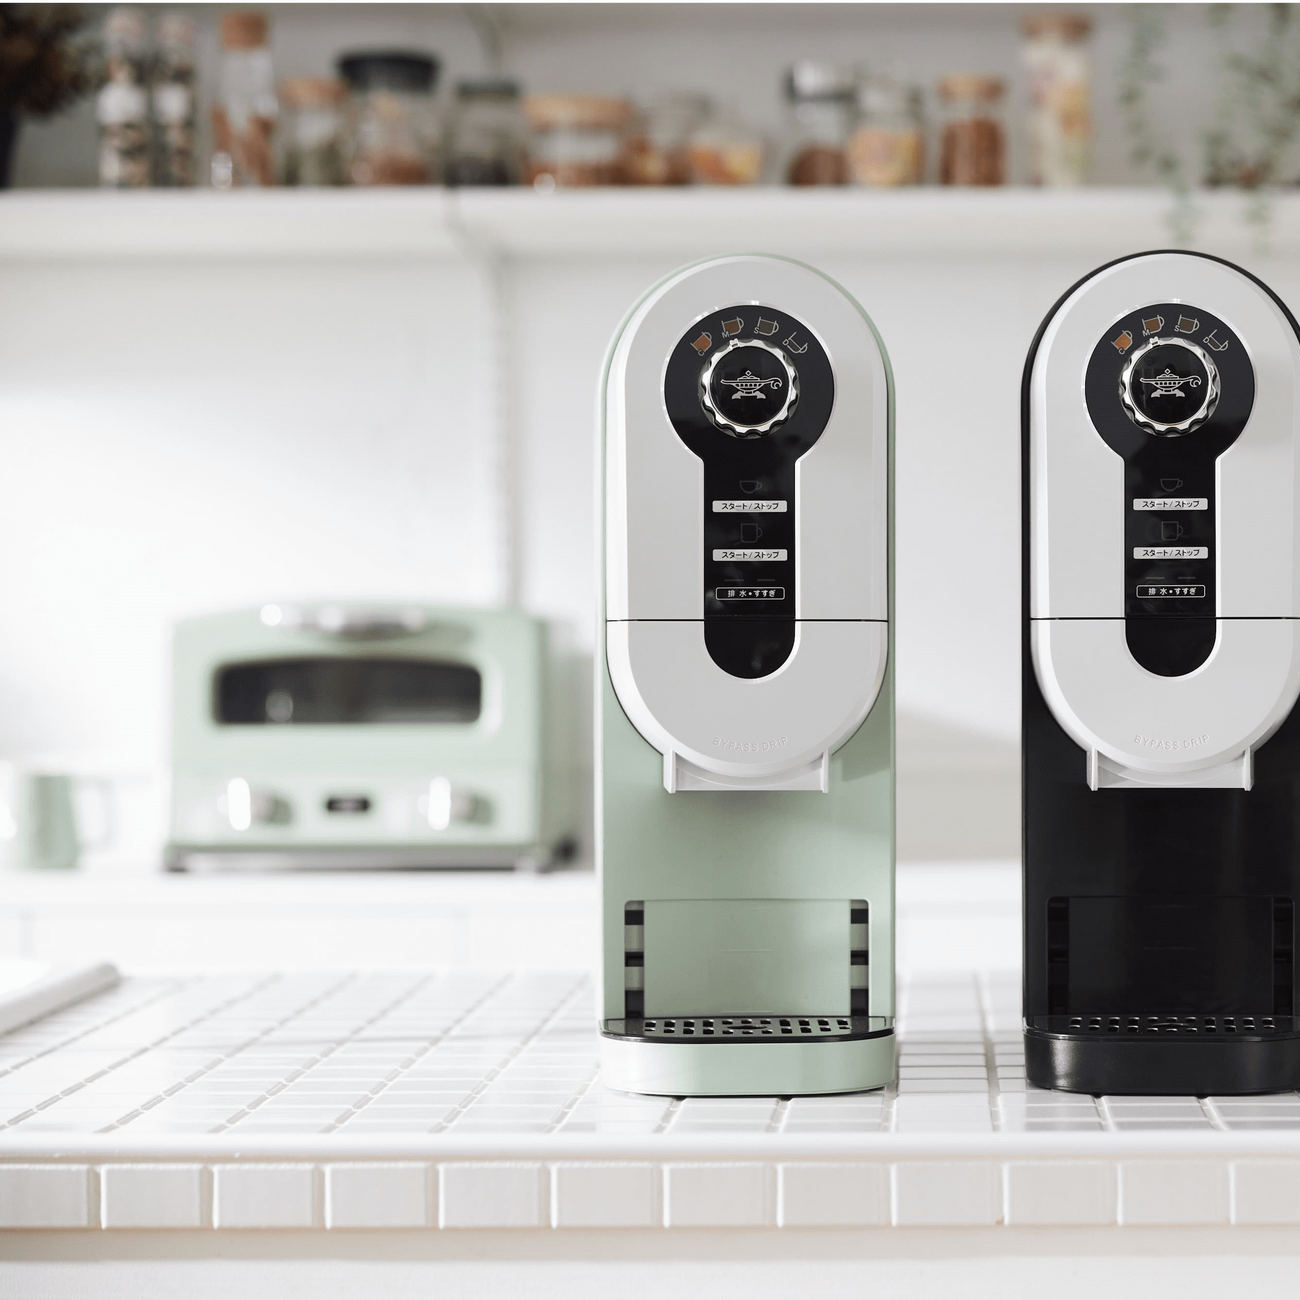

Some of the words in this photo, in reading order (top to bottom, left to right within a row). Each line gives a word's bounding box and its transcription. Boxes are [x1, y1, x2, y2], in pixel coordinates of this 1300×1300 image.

[721, 330, 730, 339] M
[753, 326, 760, 334] S
[782, 338, 789, 346] D
[1142, 328, 1150, 337] M
[1174, 324, 1181, 332] S
[1203, 336, 1209, 344] D
[712, 736, 758, 752] BYPASS
[761, 736, 788, 751] DRIP
[1134, 734, 1180, 750] BYPASS
[1183, 734, 1209, 749] DRIP
